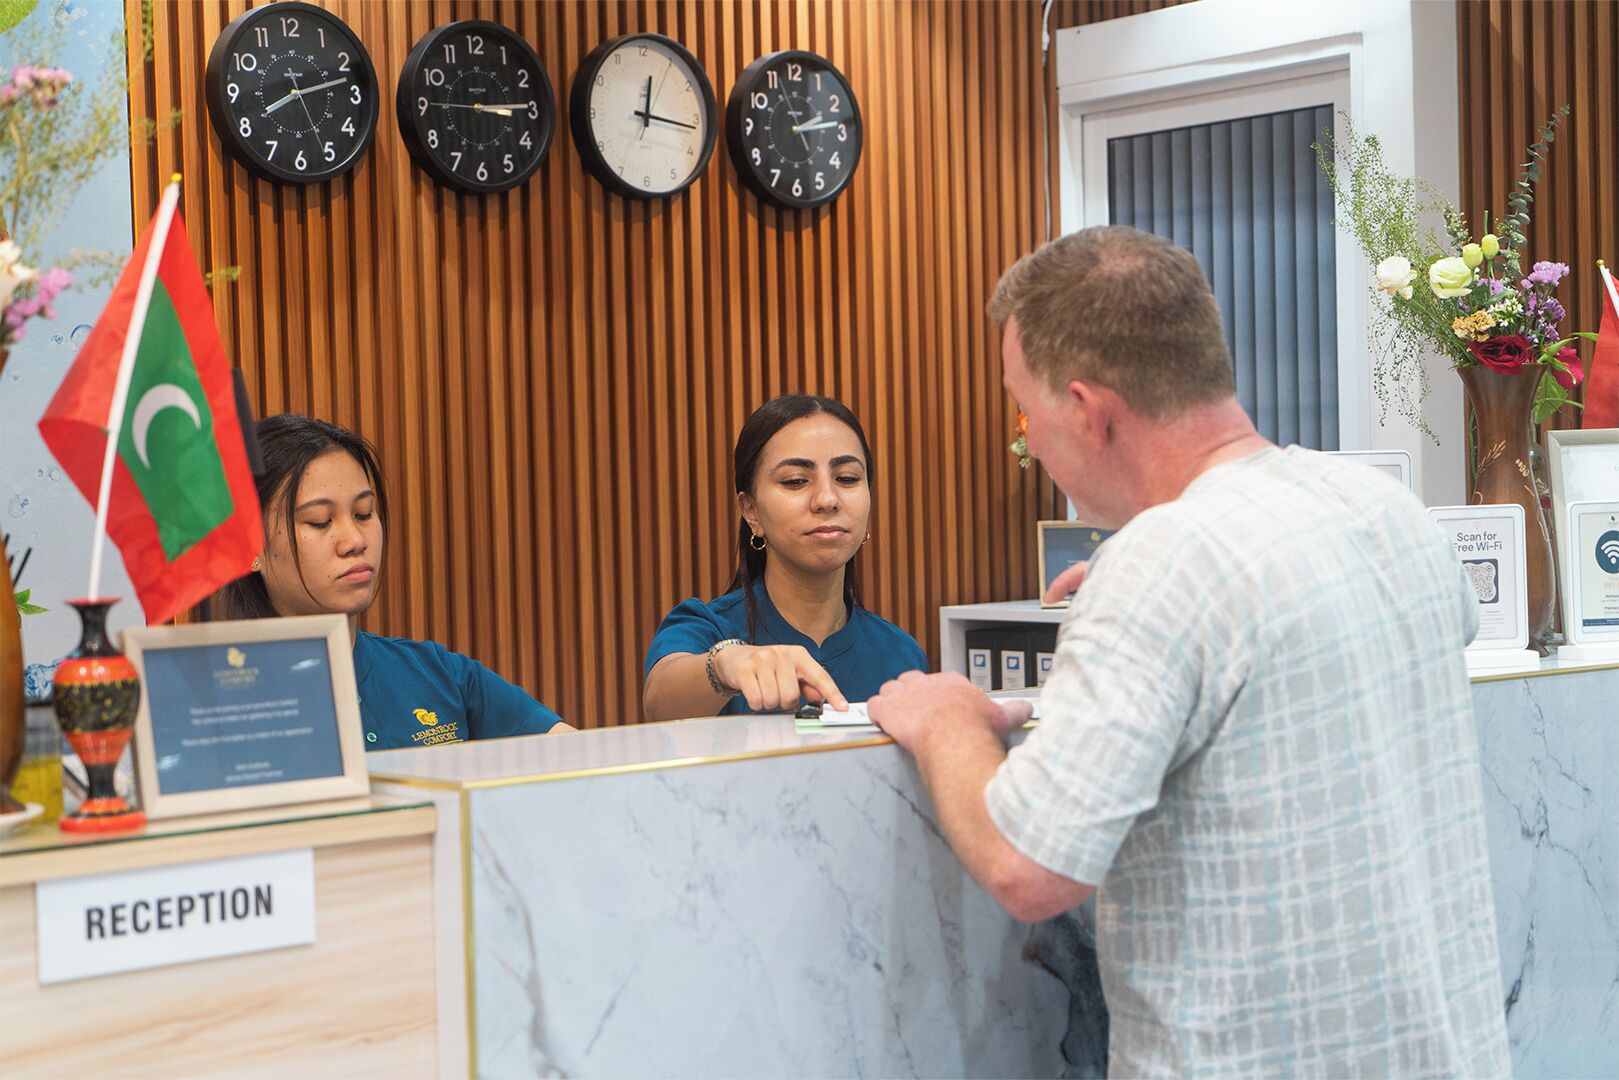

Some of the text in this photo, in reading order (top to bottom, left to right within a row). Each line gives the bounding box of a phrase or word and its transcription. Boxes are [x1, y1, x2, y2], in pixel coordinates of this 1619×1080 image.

[280, 17, 299, 37] 12
[255, 27, 268, 47] 11
[318, 28, 325, 48] 1
[466, 35, 484, 55] 12
[443, 44, 455, 64] 11
[500, 46, 506, 65] 1
[614, 54, 621, 65] 11
[638, 45, 648, 56] 12
[234, 53, 257, 71] 10
[338, 52, 350, 71] 2
[424, 68, 444, 86] 10
[518, 69, 529, 88] 2
[766, 71, 777, 89] 11
[787, 63, 802, 81] 12
[686, 81, 692, 92] 2
[815, 74, 821, 91] 1
[227, 83, 239, 103] 9
[350, 85, 361, 105] 3
[751, 92, 768, 109] 10
[418, 97, 428, 116] 9
[528, 100, 539, 119] 3
[829, 95, 839, 112] 2
[590, 108, 596, 119] 9
[693, 114, 700, 125] 3
[239, 117, 251, 137] 8
[341, 117, 355, 137] 4
[745, 117, 753, 136] 9
[837, 124, 847, 142] 3
[427, 129, 438, 148] 8
[519, 131, 532, 150] 4
[598, 141, 604, 153] 8
[266, 141, 278, 161] 7
[323, 141, 335, 161] 5
[687, 145, 694, 156] 4
[752, 148, 761, 166] 8
[829, 151, 841, 169] 4
[295, 151, 307, 170] 6
[450, 152, 462, 171] 7
[503, 154, 514, 173] 5
[476, 162, 488, 181] 6
[618, 166, 624, 177] 7
[644, 175, 650, 187] 6
[671, 168, 677, 180] 5
[770, 169, 781, 187] 7
[815, 172, 825, 190] 5
[792, 178, 802, 197] 6
[1457, 531, 1497, 541] Scan for
[1476, 541, 1502, 551] Wi-Fi
[411, 722, 458, 741] LEMONROCK
[85, 883, 274, 940] RECEPTION
